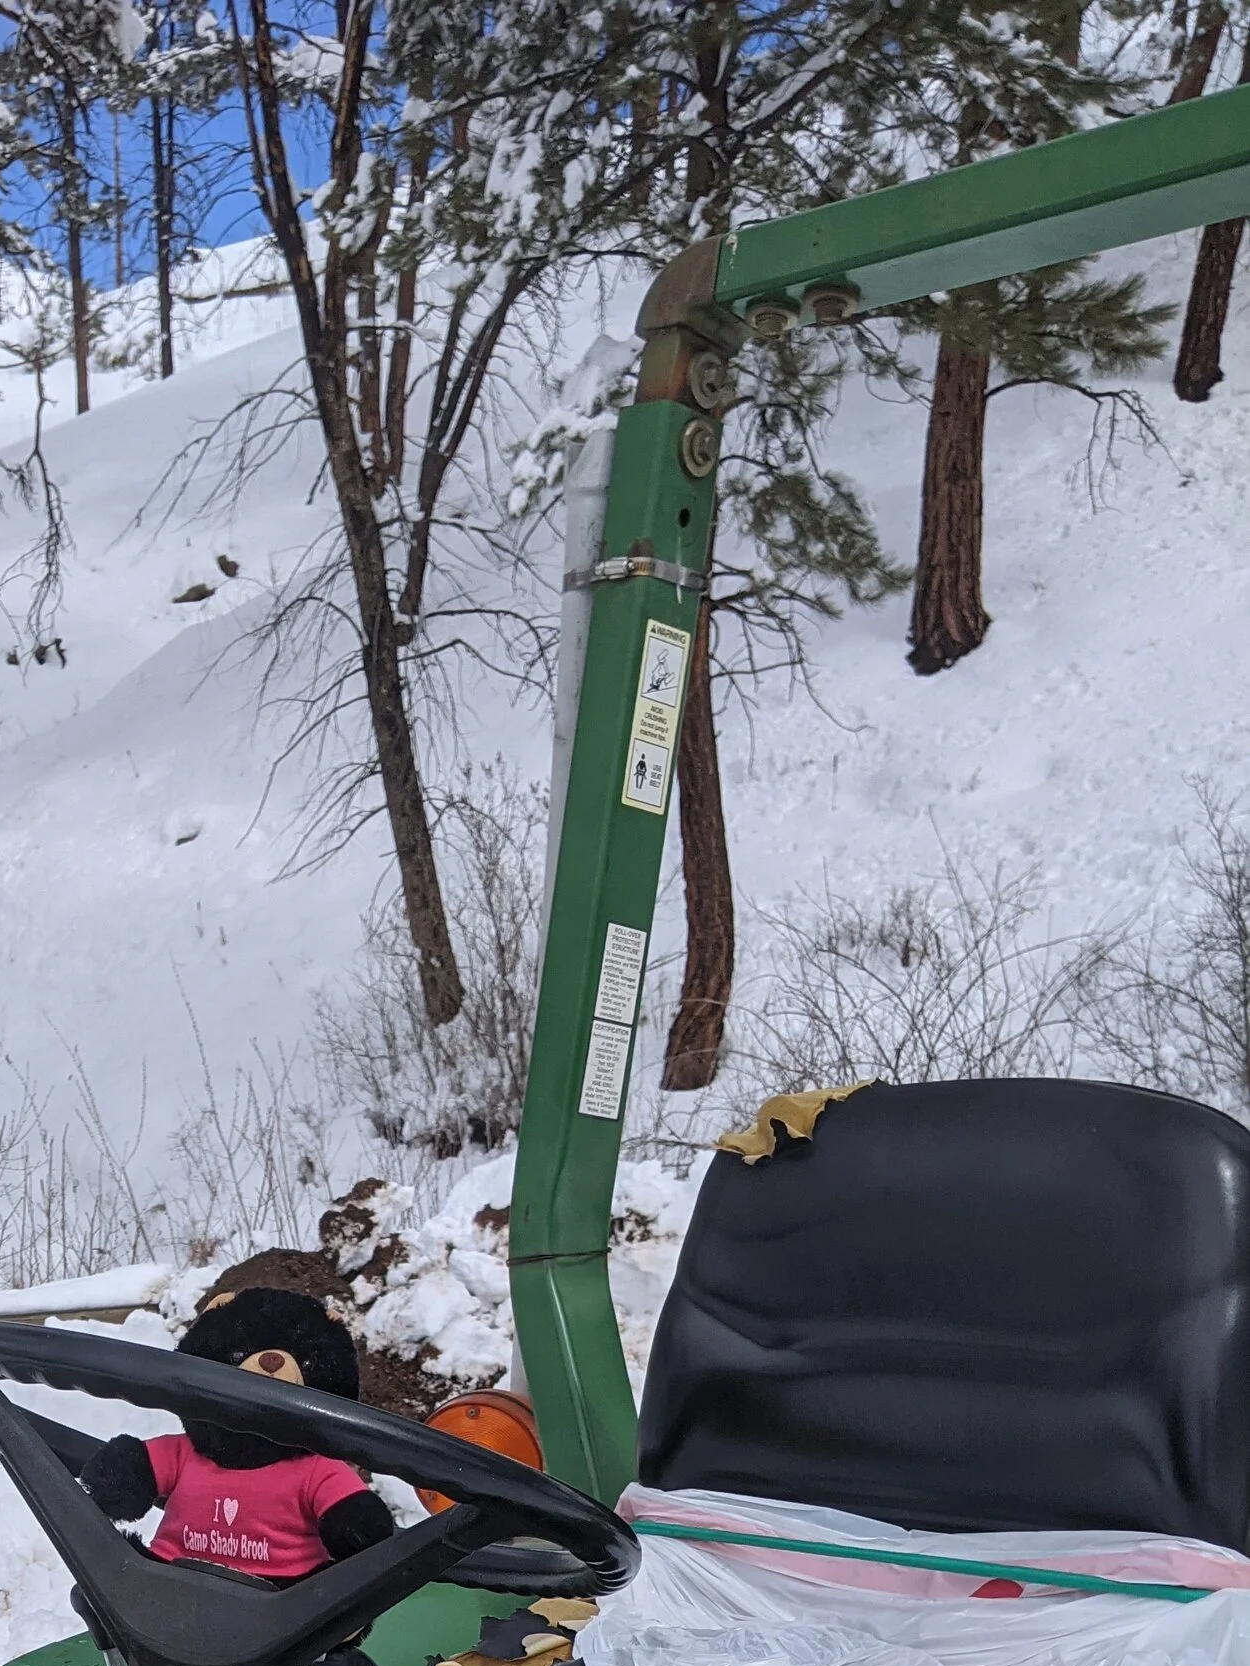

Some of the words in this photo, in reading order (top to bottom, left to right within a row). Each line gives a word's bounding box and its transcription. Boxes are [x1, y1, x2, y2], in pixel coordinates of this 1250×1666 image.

[657, 626, 686, 644] WARNING
[645, 712, 667, 725] CRUSHING
[614, 926, 641, 940] ROLL-OVER
[612, 934, 641, 948] PROTECTIVE
[611, 942, 639, 956] STRUCTURE
[594, 1023, 629, 1036] CERTIFICATION
[213, 1499, 221, 1522] I
[183, 1525, 208, 1552] Camp
[210, 1530, 239, 1557] Shady
[241, 1534, 270, 1562] Brook
